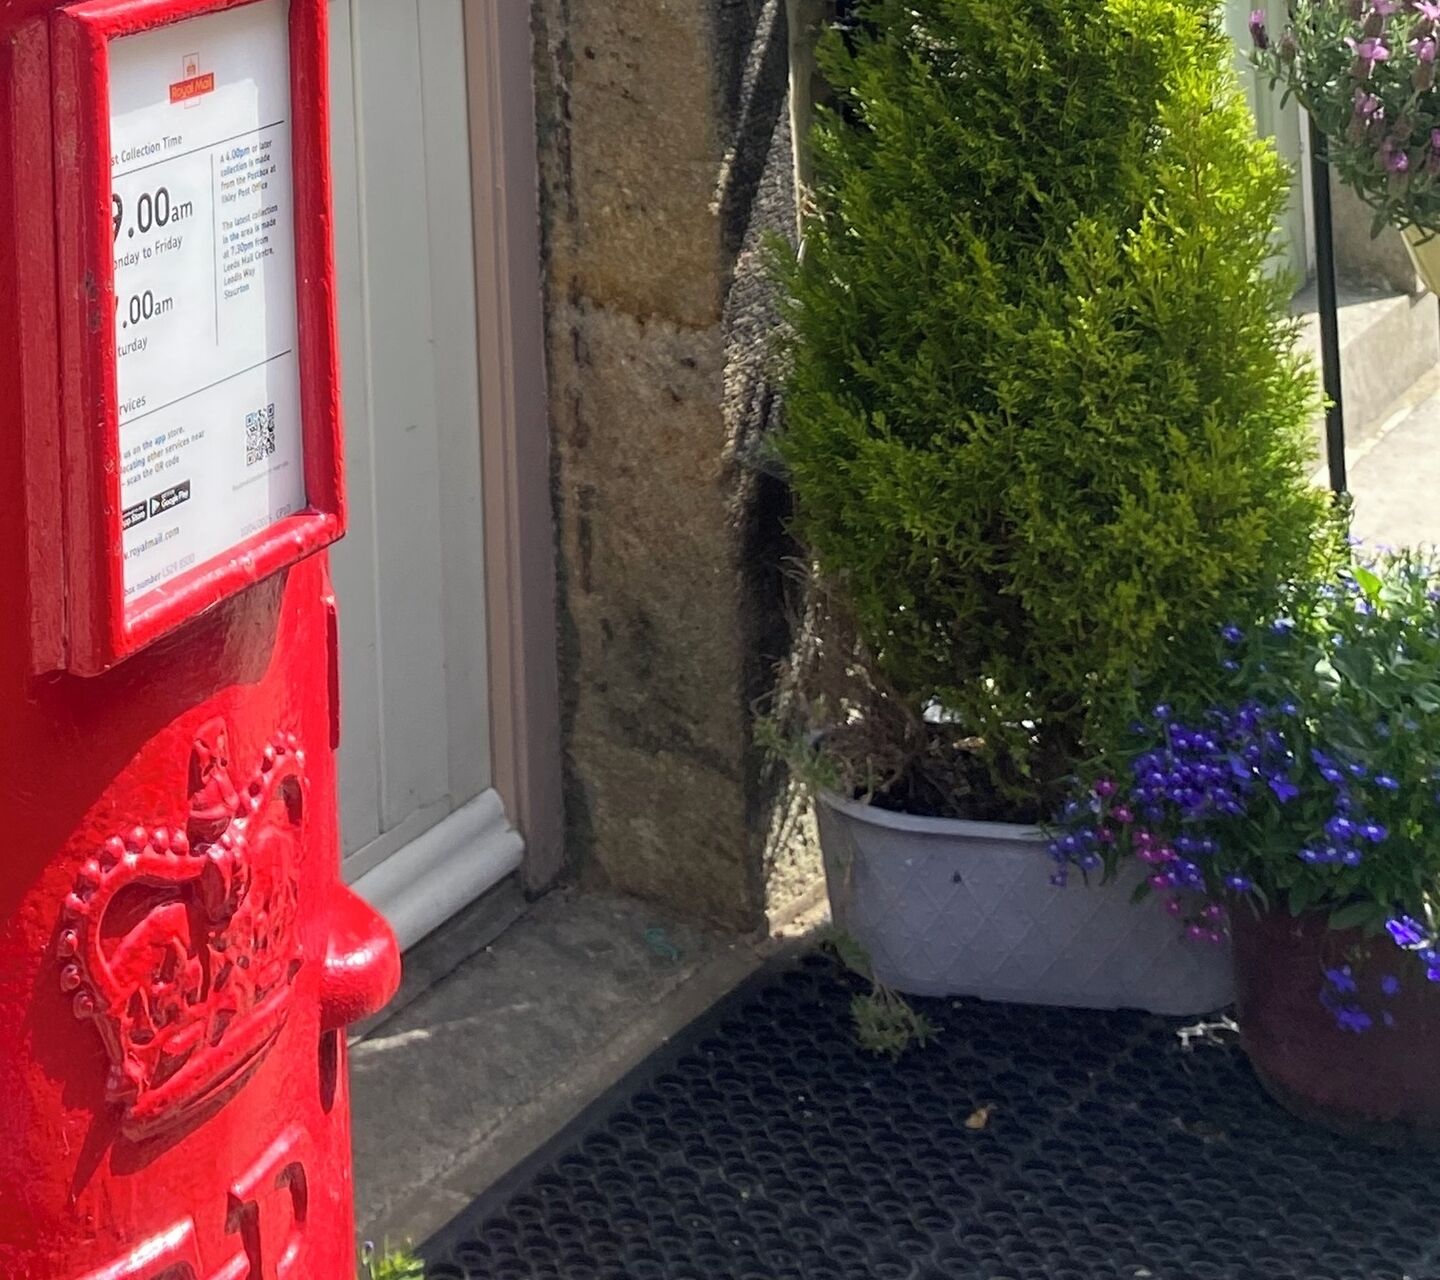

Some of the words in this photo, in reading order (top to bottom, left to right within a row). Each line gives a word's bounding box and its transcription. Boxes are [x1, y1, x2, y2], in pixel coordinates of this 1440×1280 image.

[121, 142, 161, 163] Collection
[162, 135, 183, 149] Time
[112, 187, 193, 243] 9.00am
[114, 250, 139, 270] onday
[142, 246, 152, 259] to
[155, 235, 183, 256] Friday
[116, 289, 174, 329] .00am
[118, 336, 148, 358] turday
[120, 395, 147, 416] rvices
[142, 440, 153, 450] the
[154, 434, 166, 446] app
